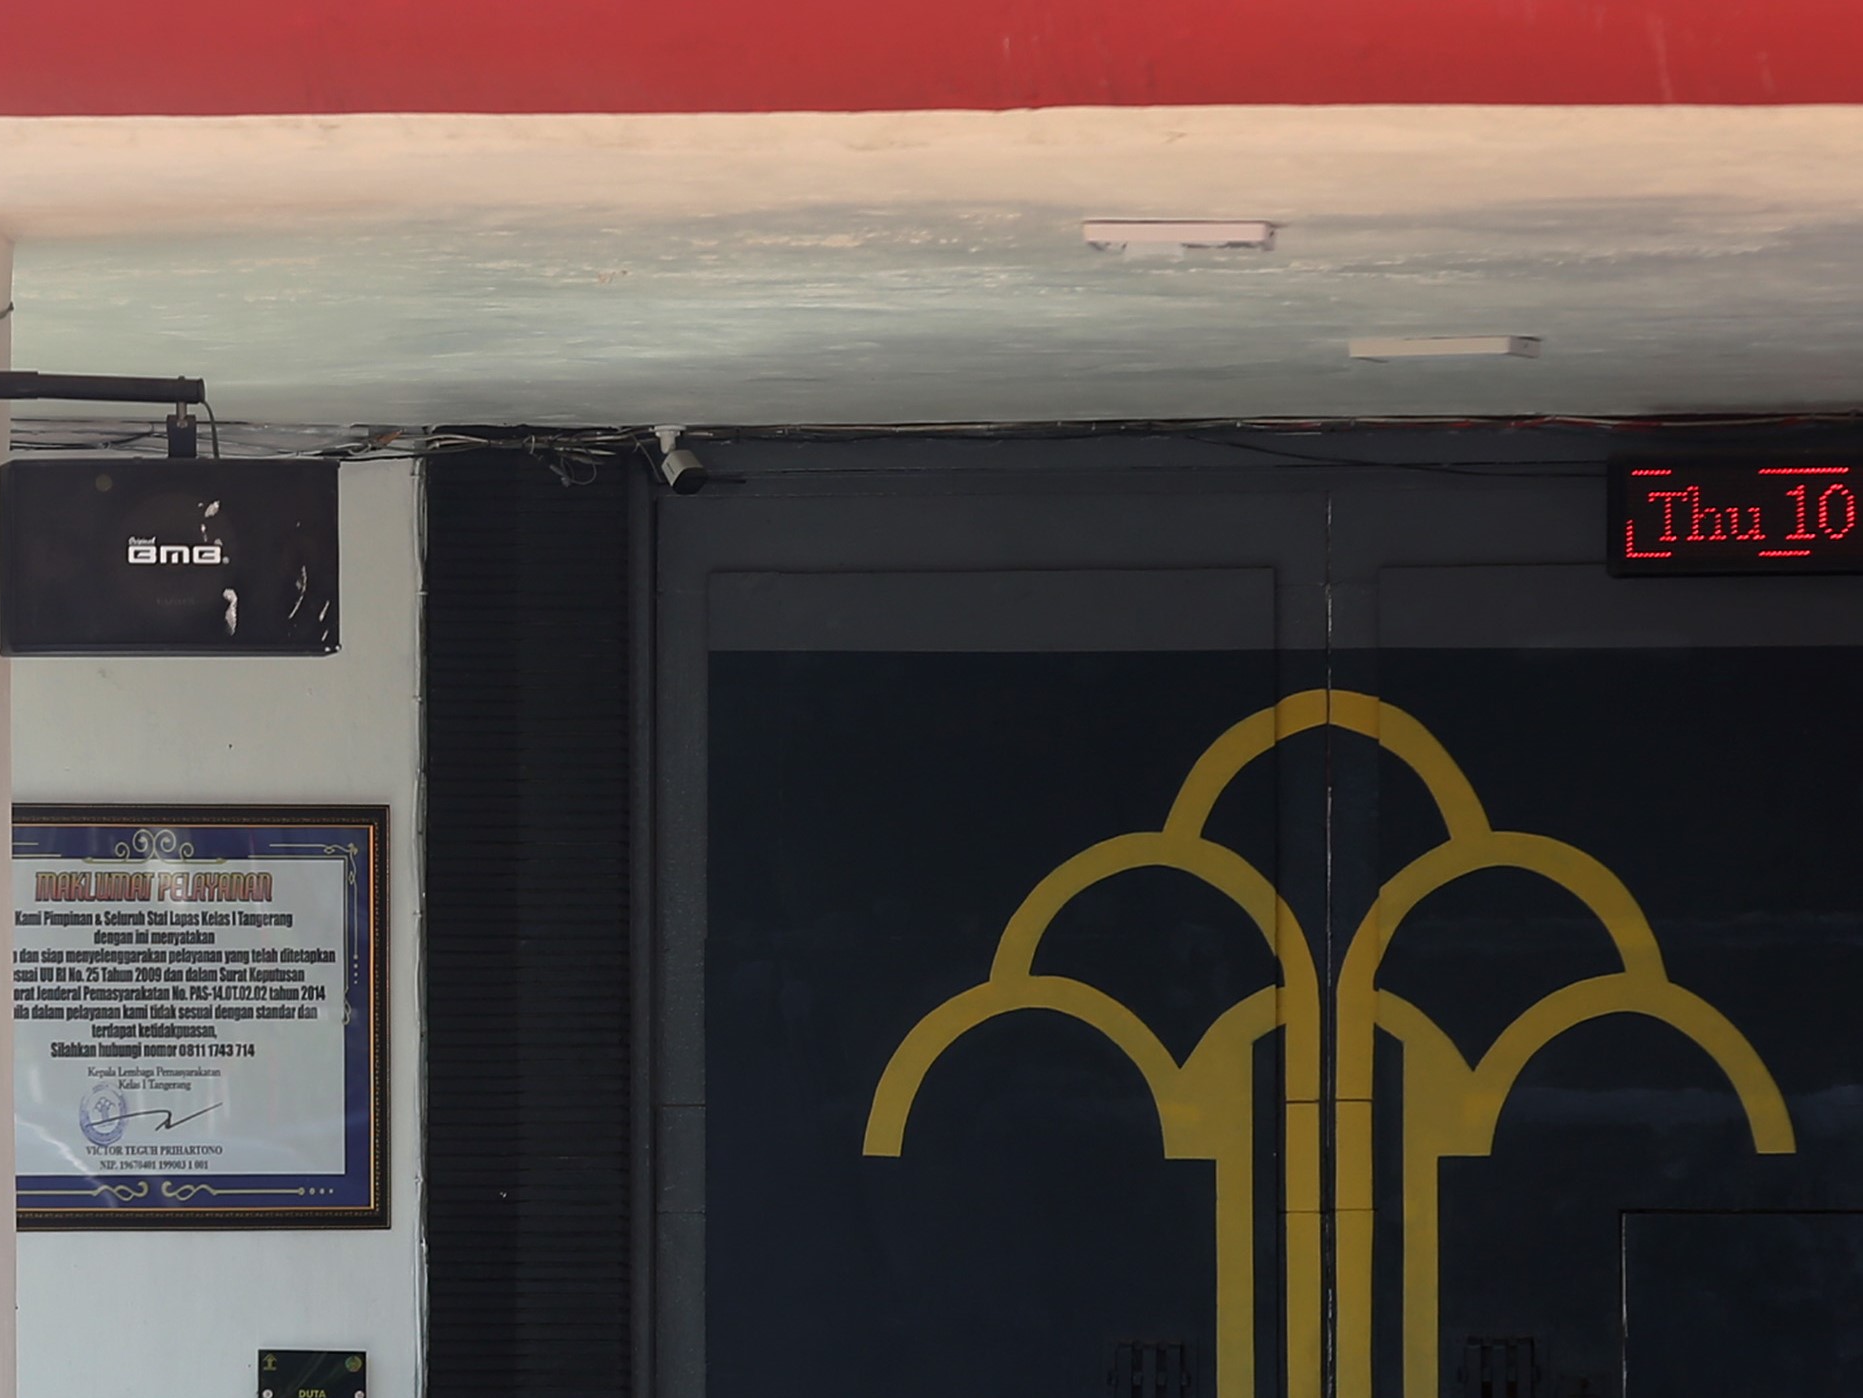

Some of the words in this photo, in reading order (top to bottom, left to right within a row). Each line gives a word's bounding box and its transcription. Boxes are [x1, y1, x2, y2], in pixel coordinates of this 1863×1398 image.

[1648, 486, 1766, 541] Thu
[1785, 484, 1855, 541] 10
[35, 872, 154, 902] MAKLUMAT
[158, 872, 273, 902] PELAYANAN
[14, 911, 41, 926] Kami
[43, 911, 93, 927] Pimpinan
[95, 912, 102, 926] &
[104, 911, 145, 926] Seluruh
[147, 911, 168, 926] Staf
[170, 911, 199, 927] Lapas
[201, 911, 229, 926] Kelas
[238, 911, 293, 927] Tangerang
[94, 930, 133, 946] dengan
[135, 930, 149, 944] ini
[151, 930, 215, 946] menyatakan
[19, 949, 39, 963] dan
[41, 949, 64, 964] siap
[66, 949, 167, 964] menyelenggarakan
[169, 949, 223, 964] pelayanan
[225, 950, 249, 964] yang
[251, 948, 278, 963] telah
[280, 948, 336, 964] ditetapkan
[68, 967, 84, 982] No.
[86, 967, 99, 982] 25
[101, 967, 133, 982] Tahun
[135, 967, 162, 982] 2009
[163, 967, 183, 982] dan
[185, 967, 217, 982] dalam
[219, 967, 247, 982] Surat
[249, 967, 305, 983] Keputusan
[36, 986, 81, 1001] Jenderal
[83, 986, 170, 1002] Pemasyarakatan
[172, 986, 188, 1001] No.
[269, 986, 299, 1000] tahun
[301, 986, 326, 1001] 2014
[31, 1005, 64, 1019] dalam
[66, 1005, 121, 1021] pelayanan
[123, 1005, 148, 1019] kami
[150, 1005, 176, 1019] tidak
[178, 1005, 212, 1019] sesuai
[215, 1005, 253, 1021] dengan
[255, 1005, 296, 1019] standar
[297, 1005, 318, 1019] dan
[92, 1023, 136, 1039] terdapat
[50, 1042, 96, 1057] Silahkan
[98, 1042, 142, 1059] hubungi
[143, 1045, 177, 1058] nomor
[178, 1043, 206, 1058] 0811
[208, 1043, 233, 1058] 1743
[236, 1043, 255, 1058] 714
[88, 1067, 116, 1078] Kepala
[118, 1066, 154, 1078] Lembaga
[118, 1079, 140, 1090] Kelas
[148, 1079, 191, 1091] Tangerang
[86, 1145, 123, 1155] VICTOR
[125, 1145, 158, 1155] TEGUH
[298, 1389, 327, 1398] DUTA
